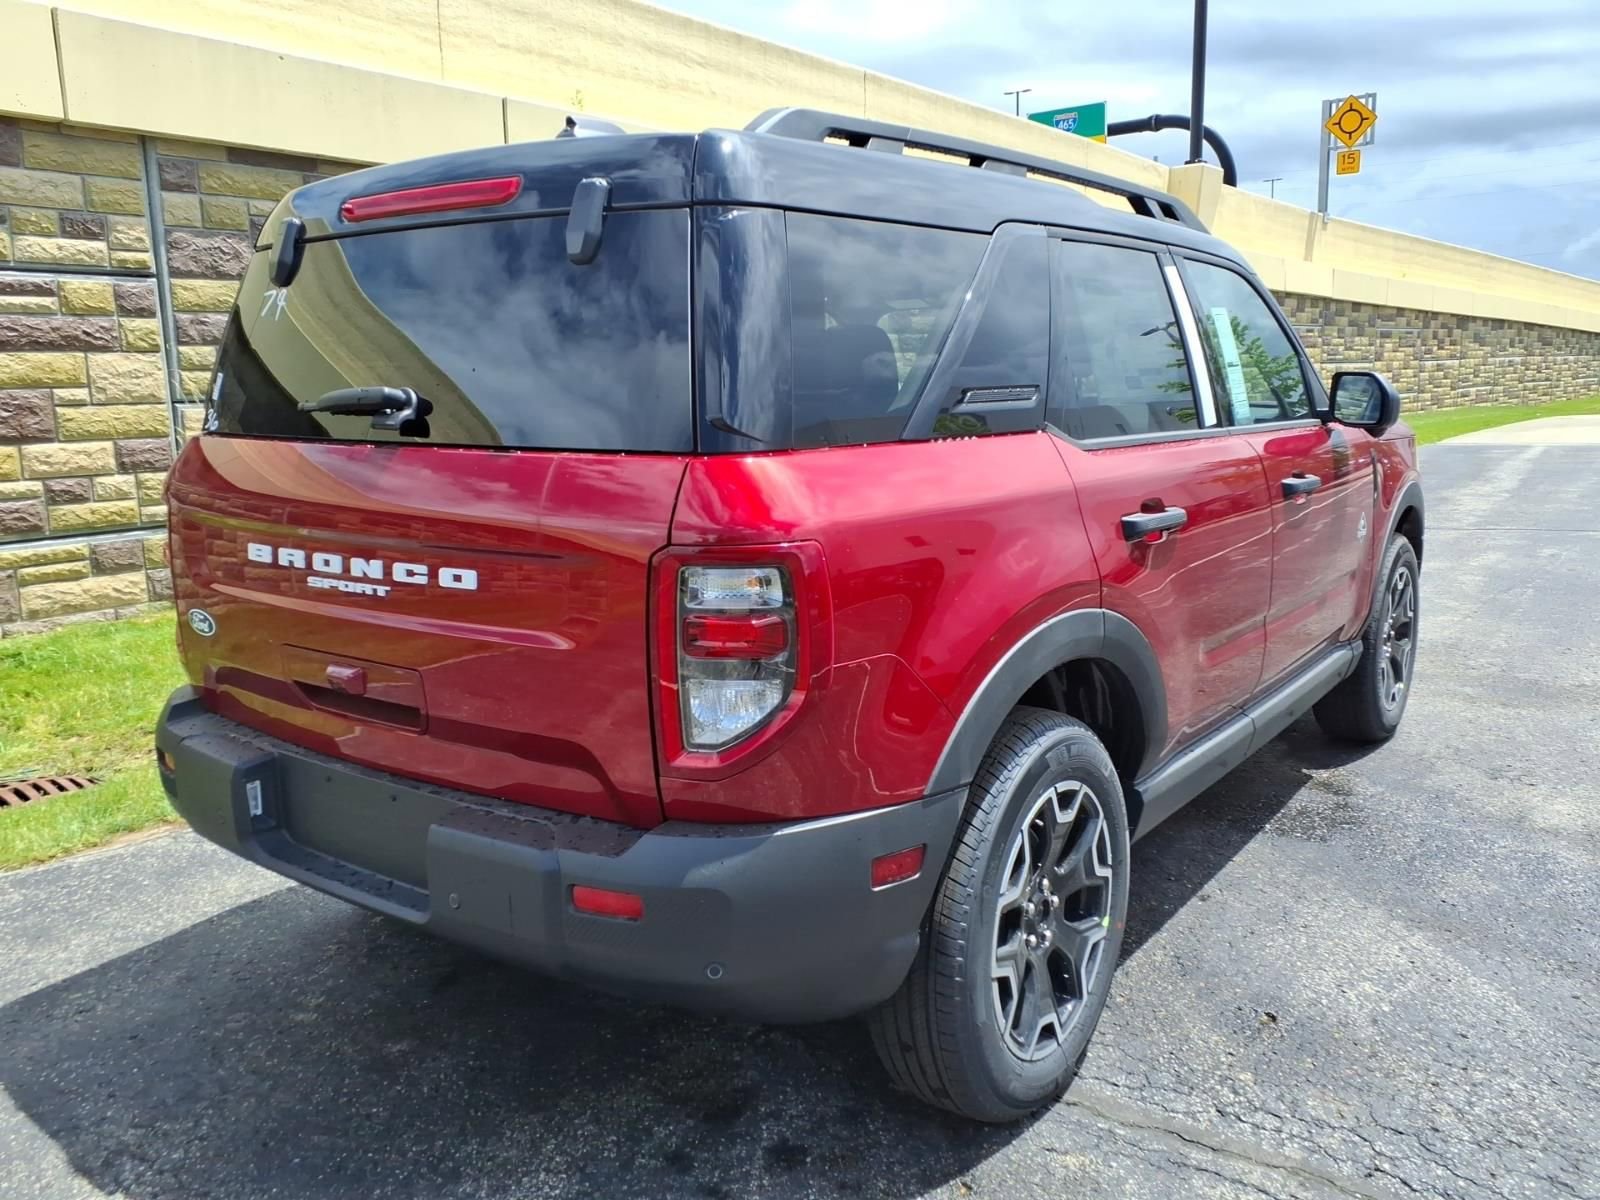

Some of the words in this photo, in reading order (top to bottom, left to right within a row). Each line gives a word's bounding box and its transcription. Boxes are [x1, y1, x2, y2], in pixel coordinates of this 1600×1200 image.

[1058, 119, 1074, 130] 465
[1342, 153, 1356, 166] 15
[247, 542, 478, 590] BRONCO
[306, 575, 392, 597] SPORT
[191, 611, 211, 632] Ford
